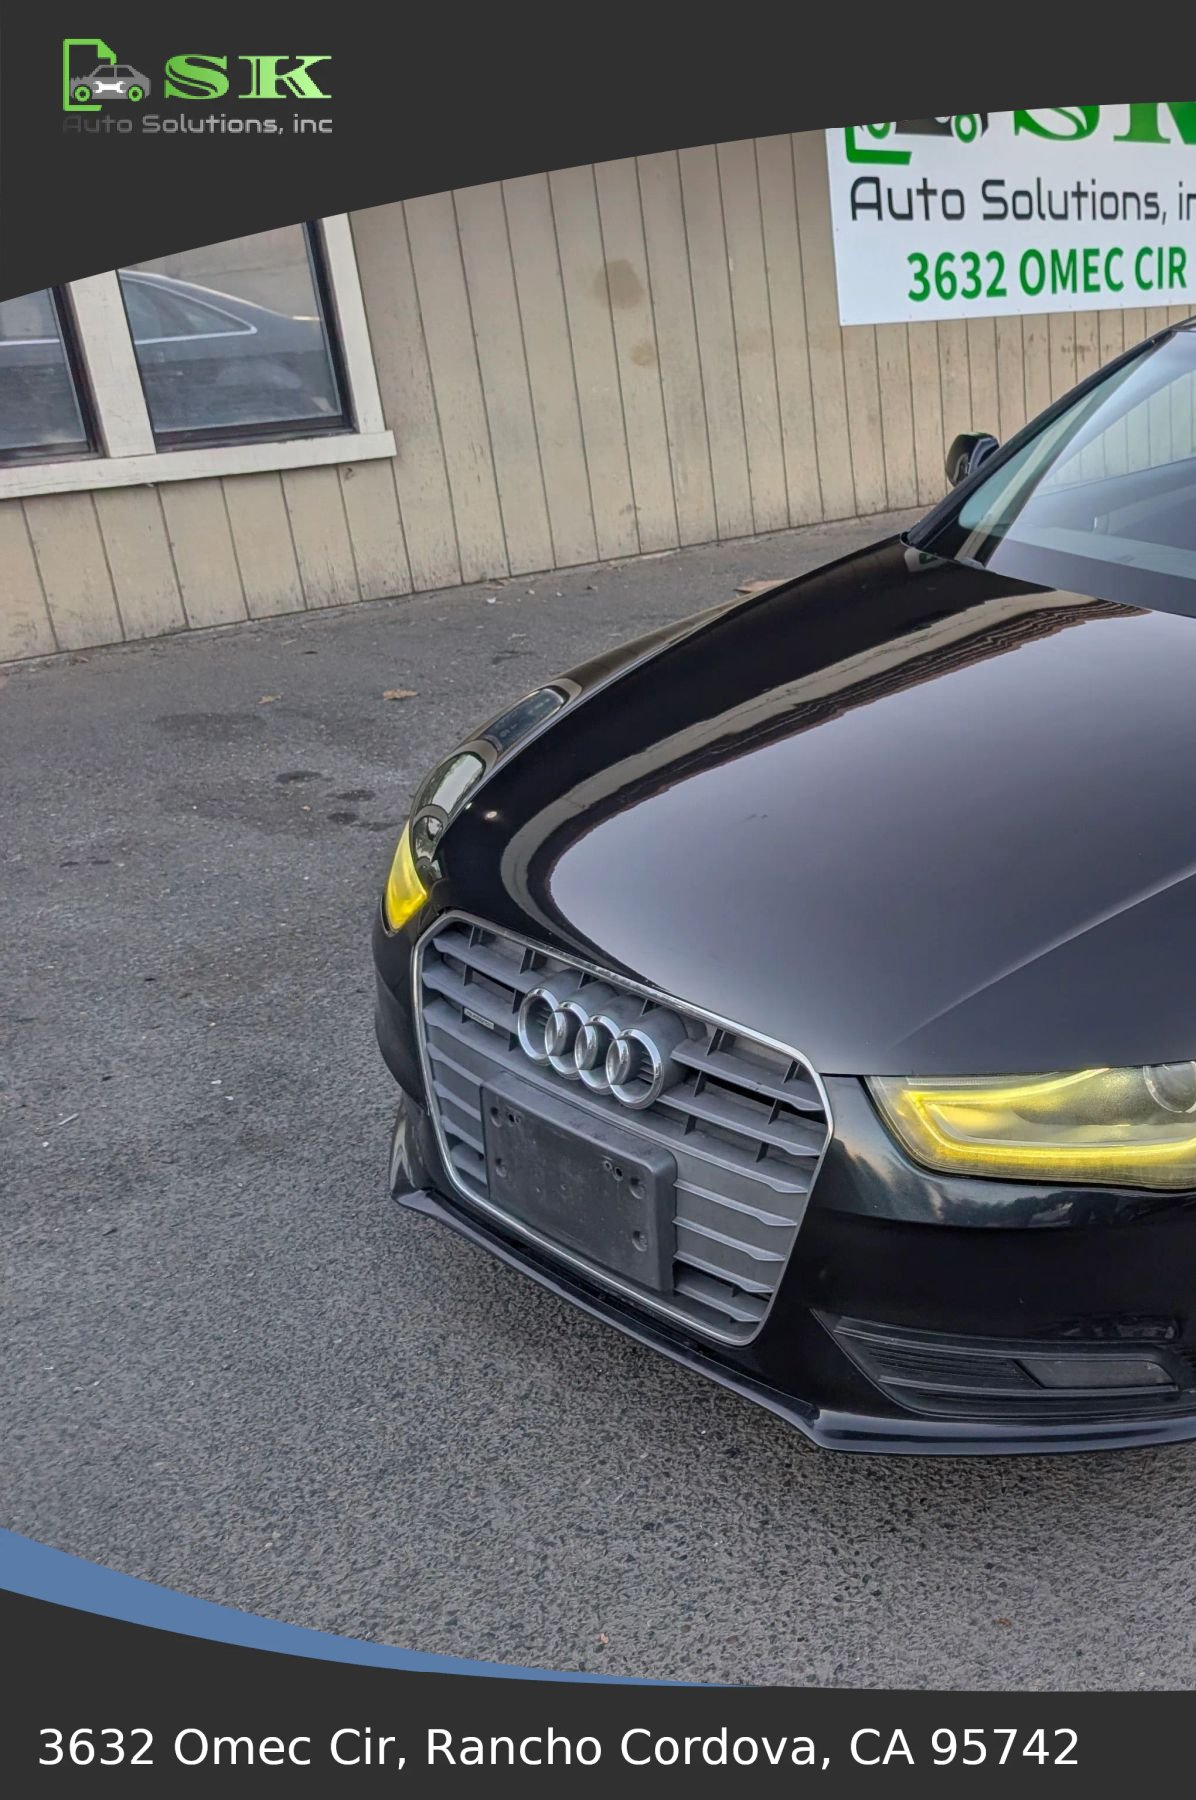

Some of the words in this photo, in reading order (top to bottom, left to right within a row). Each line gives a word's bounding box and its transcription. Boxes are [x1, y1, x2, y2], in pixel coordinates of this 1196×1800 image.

[851, 176, 964, 221] Auto
[981, 177, 1168, 225] Solutions,
[907, 251, 1007, 301] 3632
[1019, 247, 1124, 296] OMEC
[1134, 245, 1187, 289] CIR
